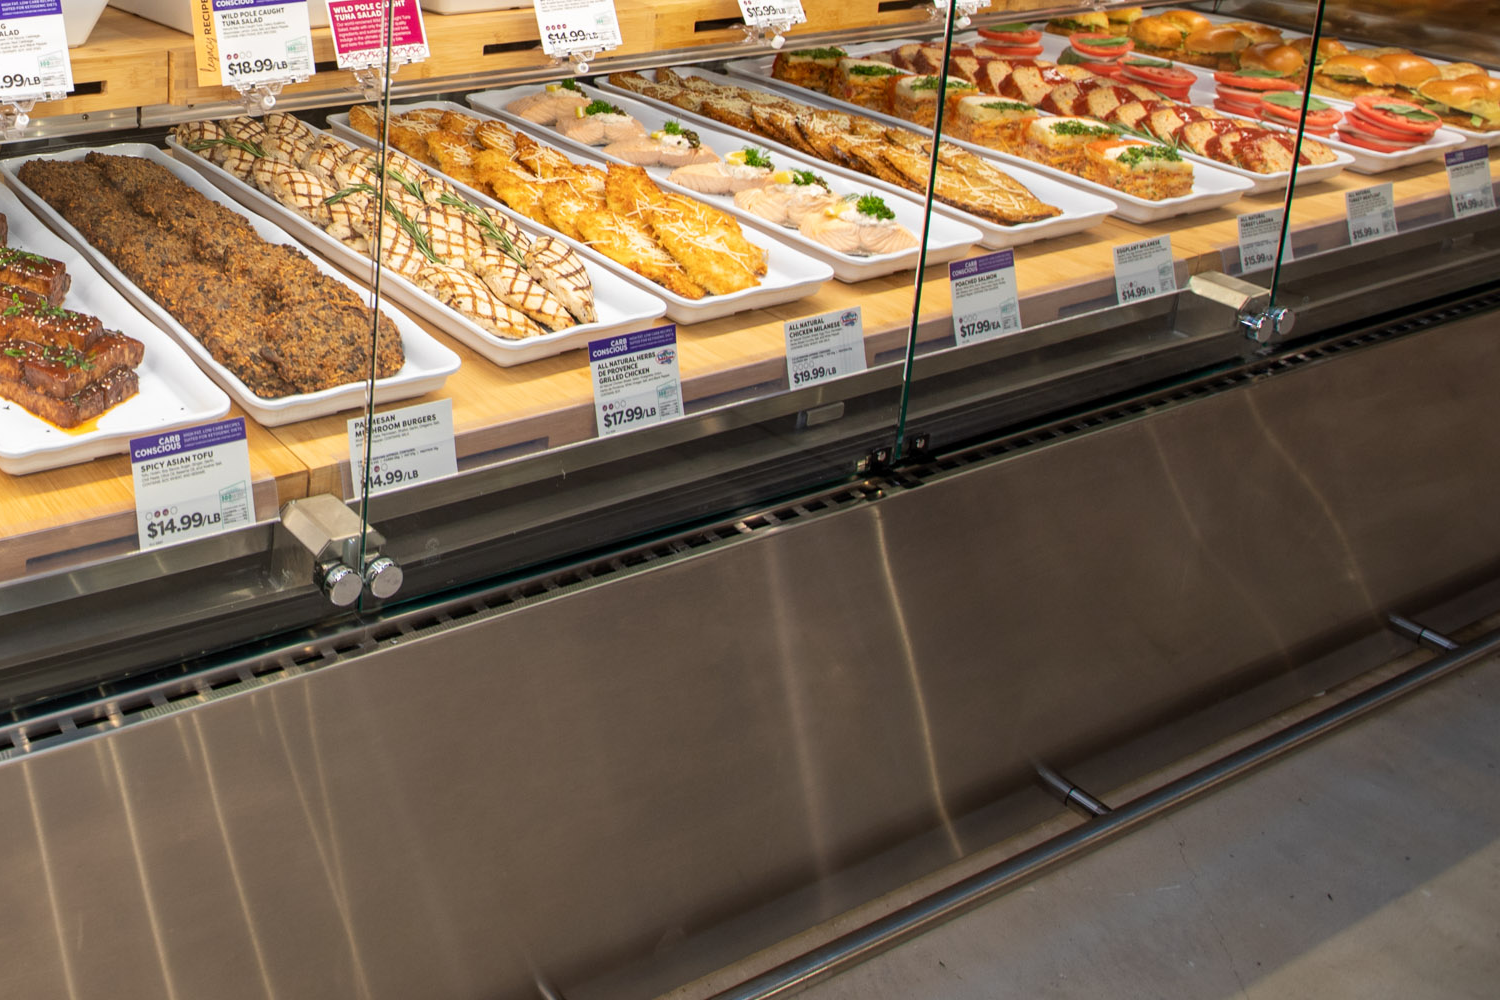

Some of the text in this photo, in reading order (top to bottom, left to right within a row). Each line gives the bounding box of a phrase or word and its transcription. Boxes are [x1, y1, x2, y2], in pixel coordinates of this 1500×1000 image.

[221, 11, 238, 19] WILD
[258, 7, 285, 15] CAUGHT
[228, 58, 288, 76] $18.99/LB
[955, 274, 997, 287] POACHED SALMON
[789, 321, 840, 338] CHICKEN MILANESE
[800, 318, 824, 328] NATURAL
[960, 320, 1001, 338] $17.99/EA
[611, 338, 628, 347] CARB
[593, 346, 628, 358] CONSCIOUS
[609, 356, 636, 367] NATURAL
[636, 352, 655, 361] HERBS
[599, 368, 650, 384] GRILLED CHICKEN
[607, 363, 638, 375] PROVENCE
[794, 366, 836, 384] $19.99/LB
[402, 414, 437, 427] BURGERS
[604, 406, 657, 428] $17.99/LB
[159, 434, 181, 446] CARB
[135, 443, 181, 458] CONSCIOUS
[141, 451, 214, 473] SPICY ASIAN TOFU
[147, 511, 221, 539] $14.99/LB
